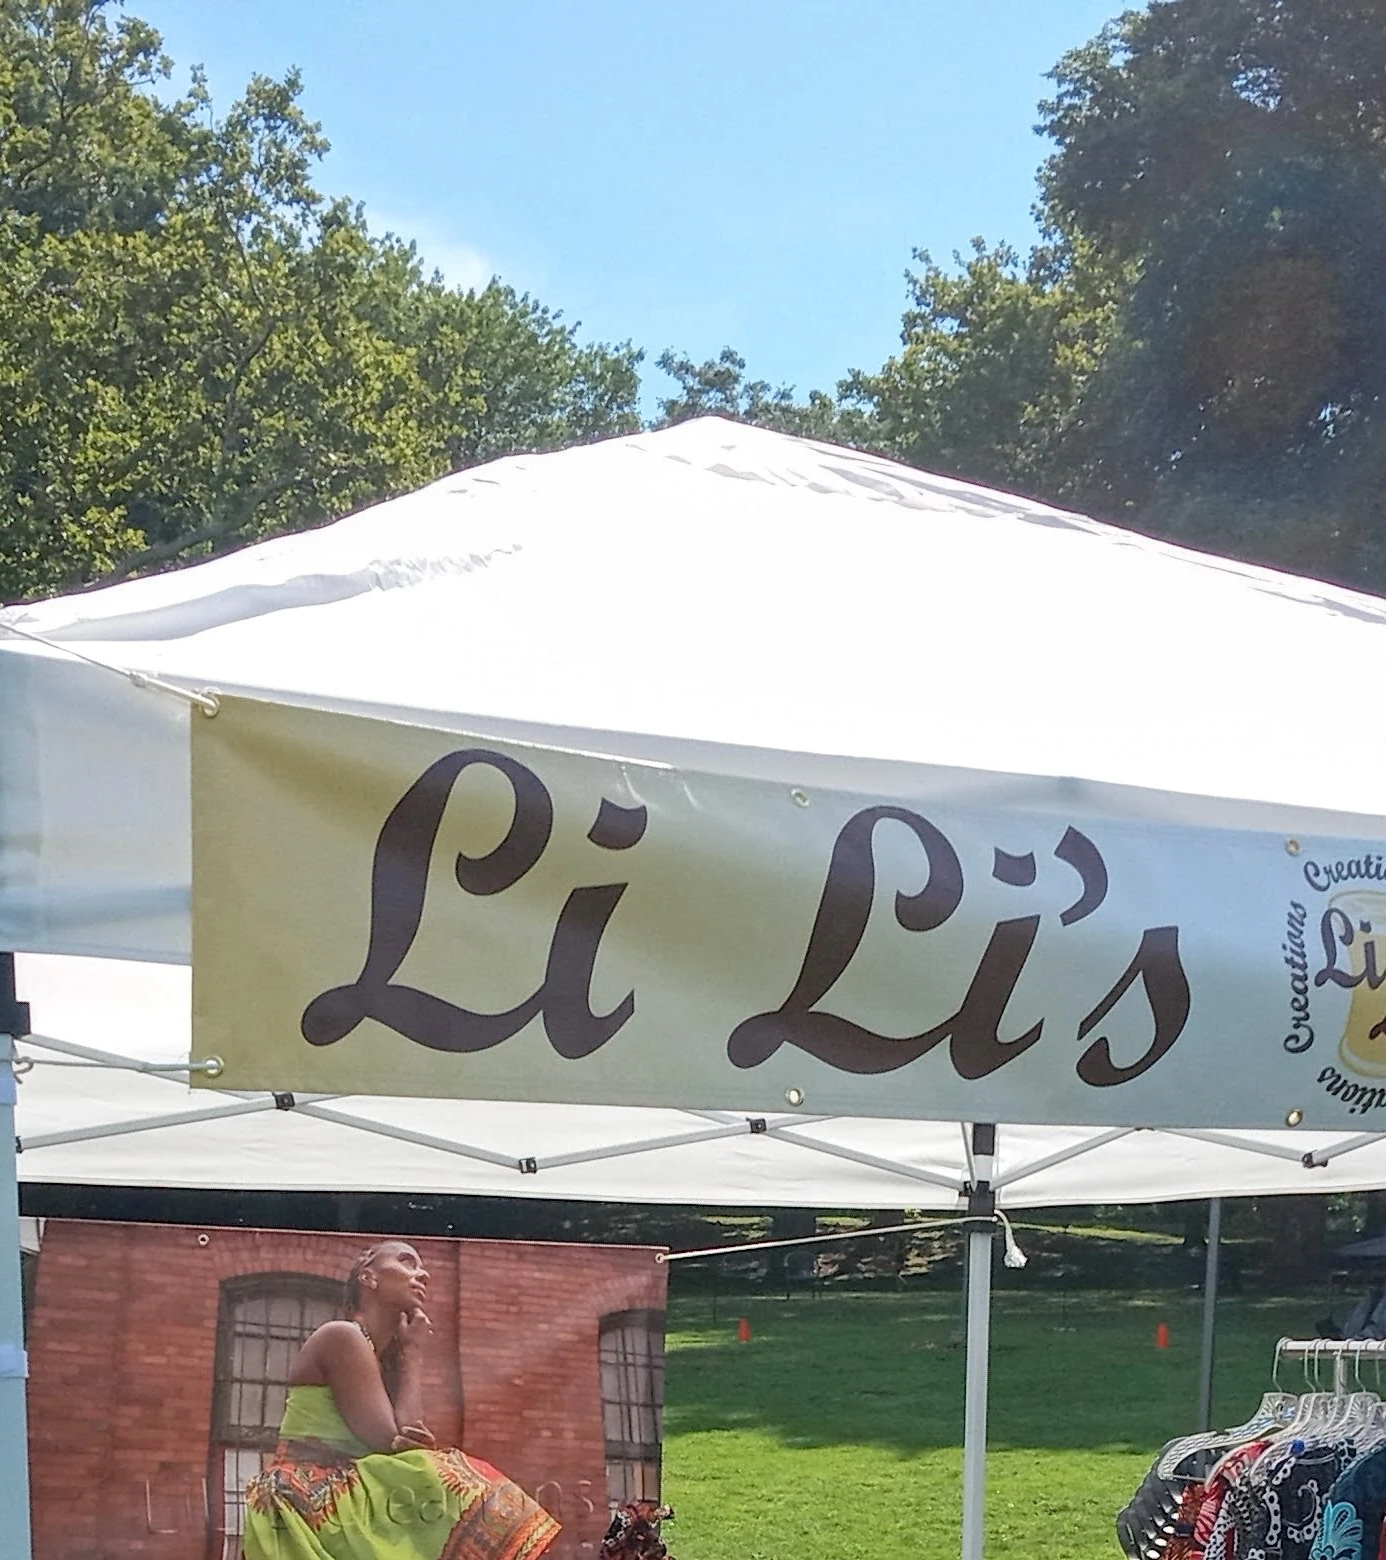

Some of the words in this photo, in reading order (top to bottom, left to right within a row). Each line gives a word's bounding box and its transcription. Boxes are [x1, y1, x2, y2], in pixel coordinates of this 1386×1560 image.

[301, 748, 634, 1060] Li
[726, 805, 1190, 1088] Li's
[1281, 900, 1314, 1053] Creations
[1314, 907, 1386, 990] Li
